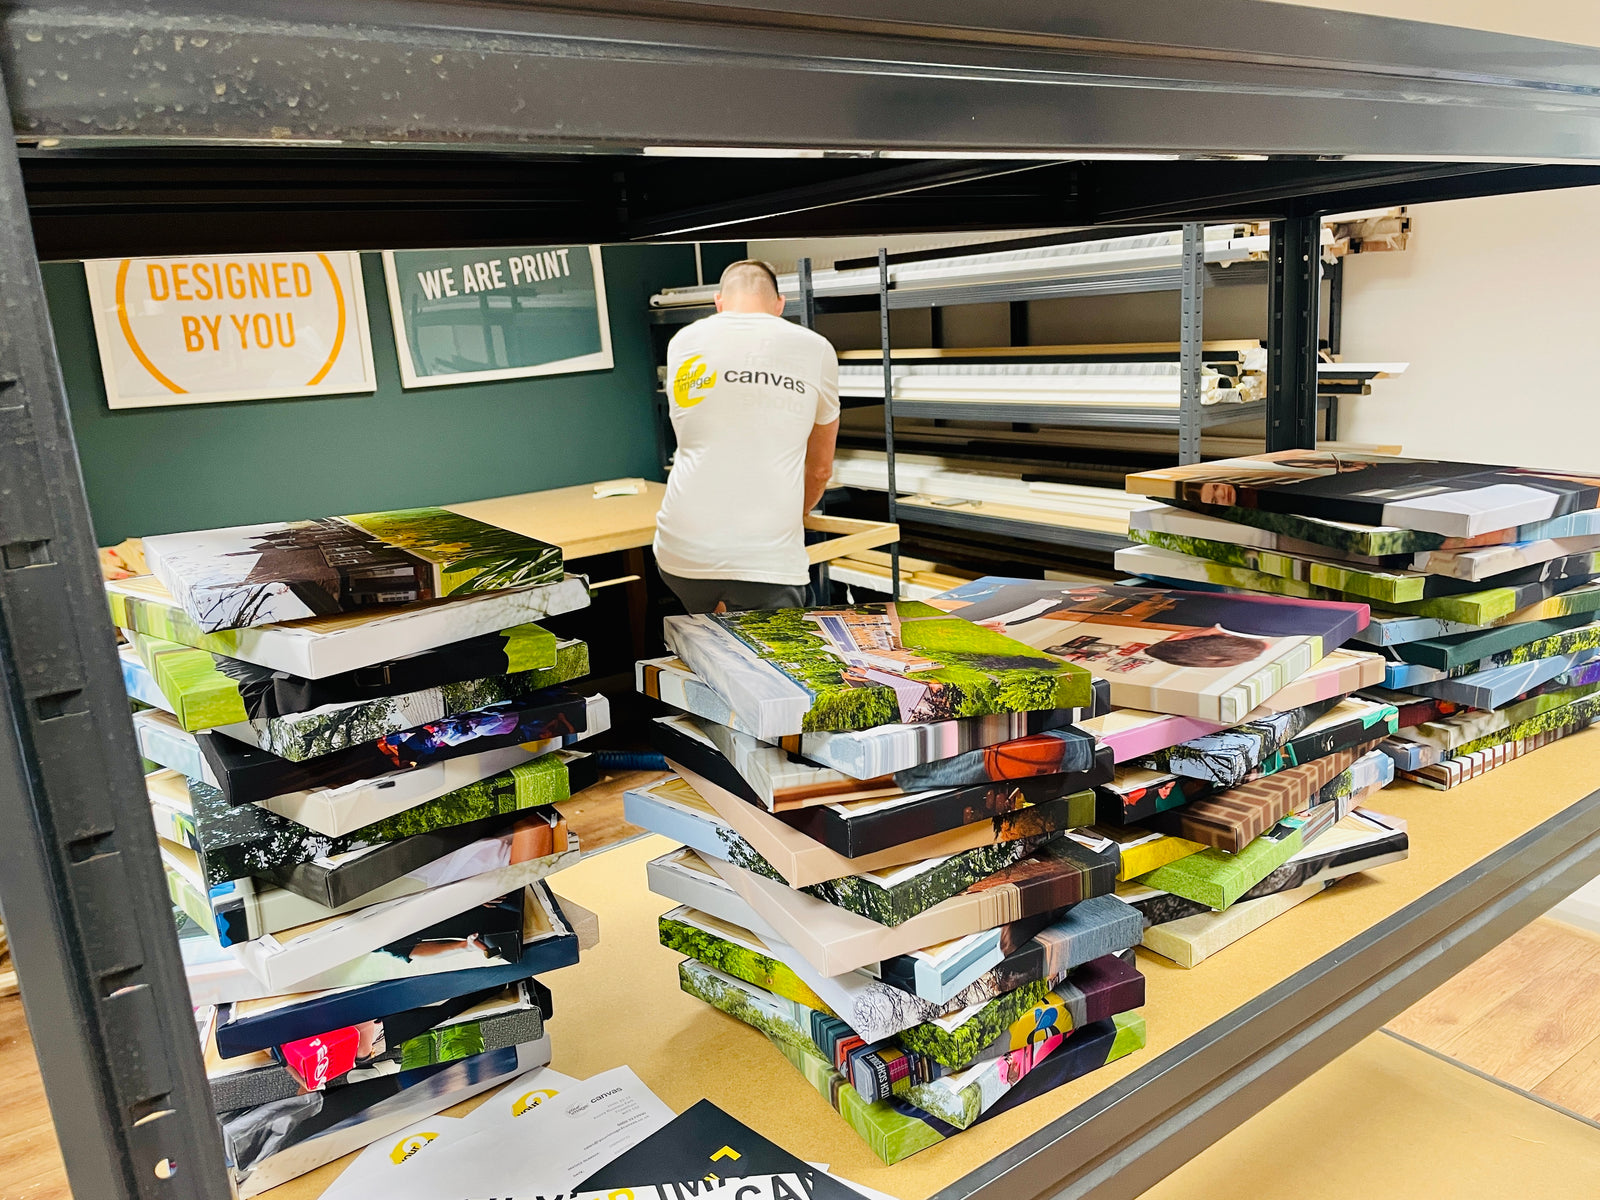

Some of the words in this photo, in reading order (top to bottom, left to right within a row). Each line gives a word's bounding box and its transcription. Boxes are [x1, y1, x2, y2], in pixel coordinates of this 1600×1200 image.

[146, 261, 312, 302] DESIGNED
[417, 266, 458, 301] WE
[463, 258, 506, 294] ARE
[508, 249, 571, 286] PRINT
[182, 314, 228, 353] BY
[230, 311, 296, 350] YOU
[679, 376, 711, 392] image
[723, 369, 806, 394] canvas
[590, 1087, 623, 1104] canvas
[516, 1101, 539, 1116] our
[400, 1146, 420, 1164] our
